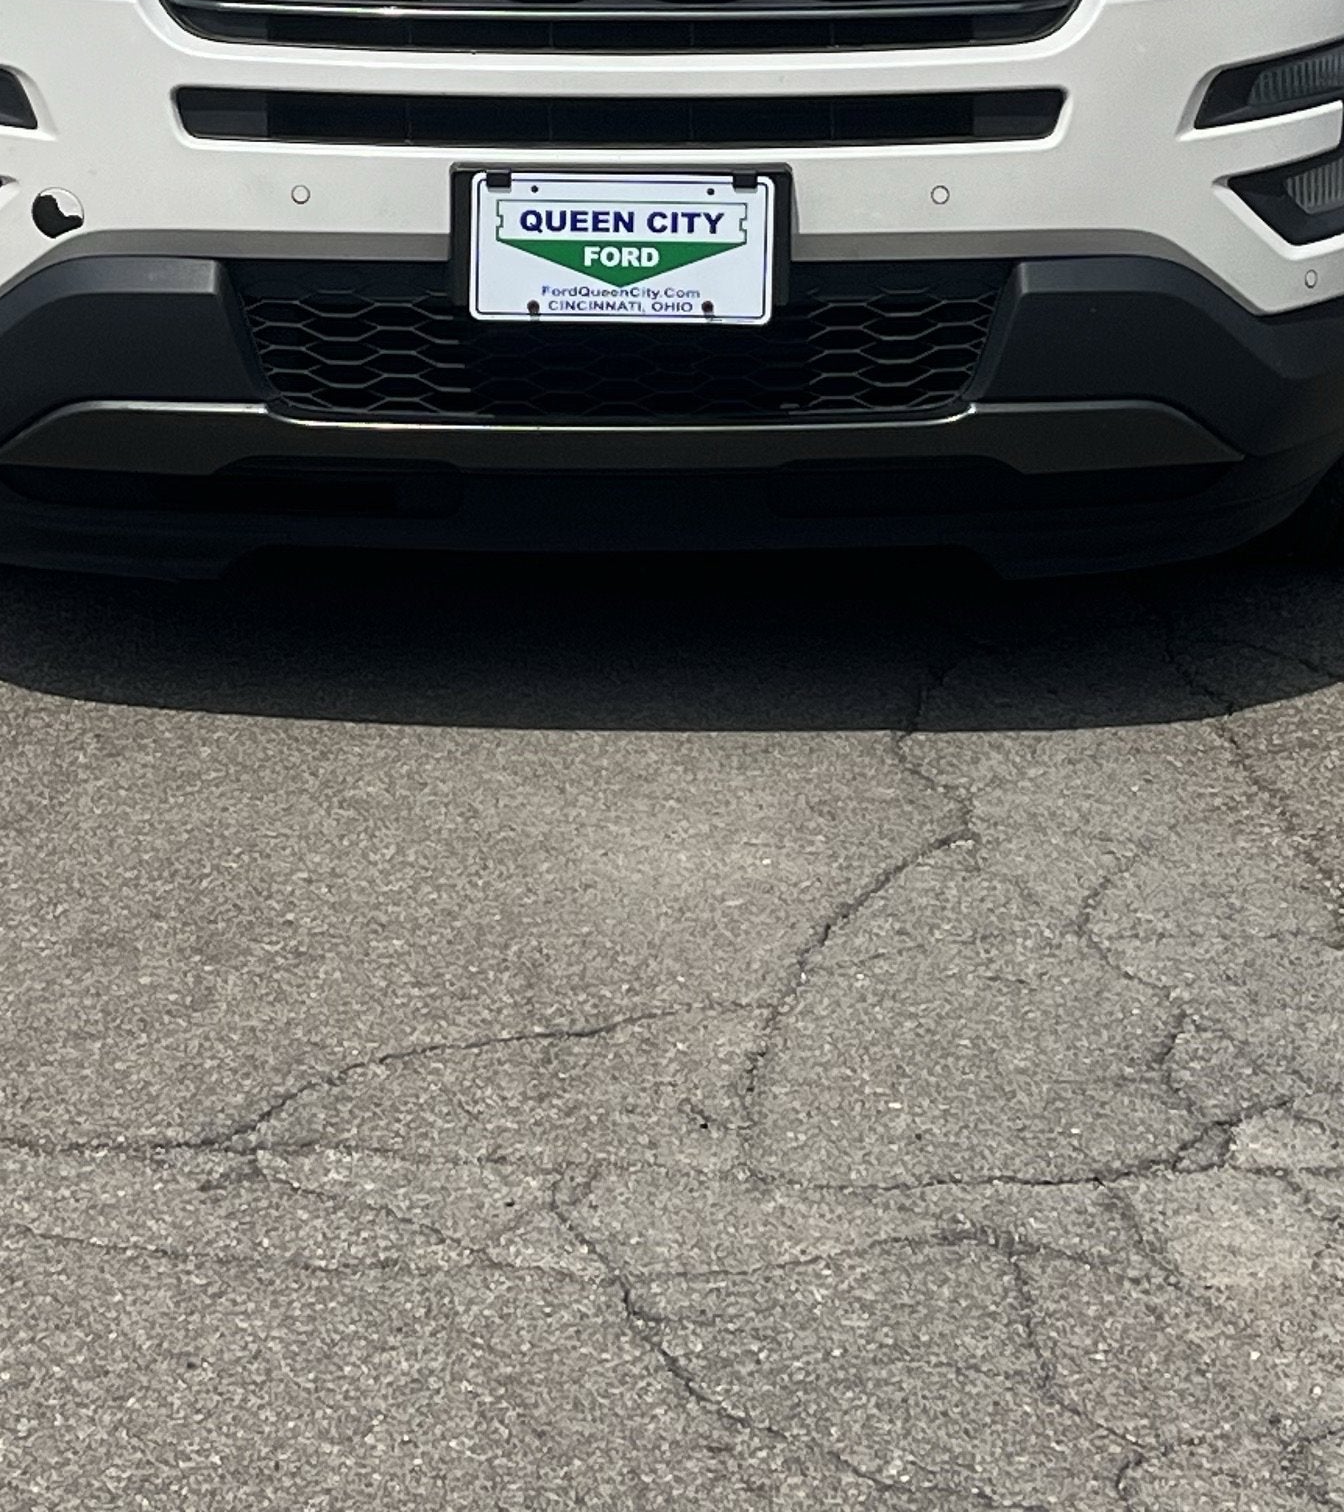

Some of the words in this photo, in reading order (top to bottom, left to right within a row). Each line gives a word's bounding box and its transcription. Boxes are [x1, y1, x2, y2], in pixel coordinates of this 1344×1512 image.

[519, 209, 635, 234] QUEEN
[646, 211, 725, 235] CITY
[583, 245, 660, 268] FORD
[541, 285, 701, 301] FordQueenCity.Com
[651, 300, 694, 314] OHIO
